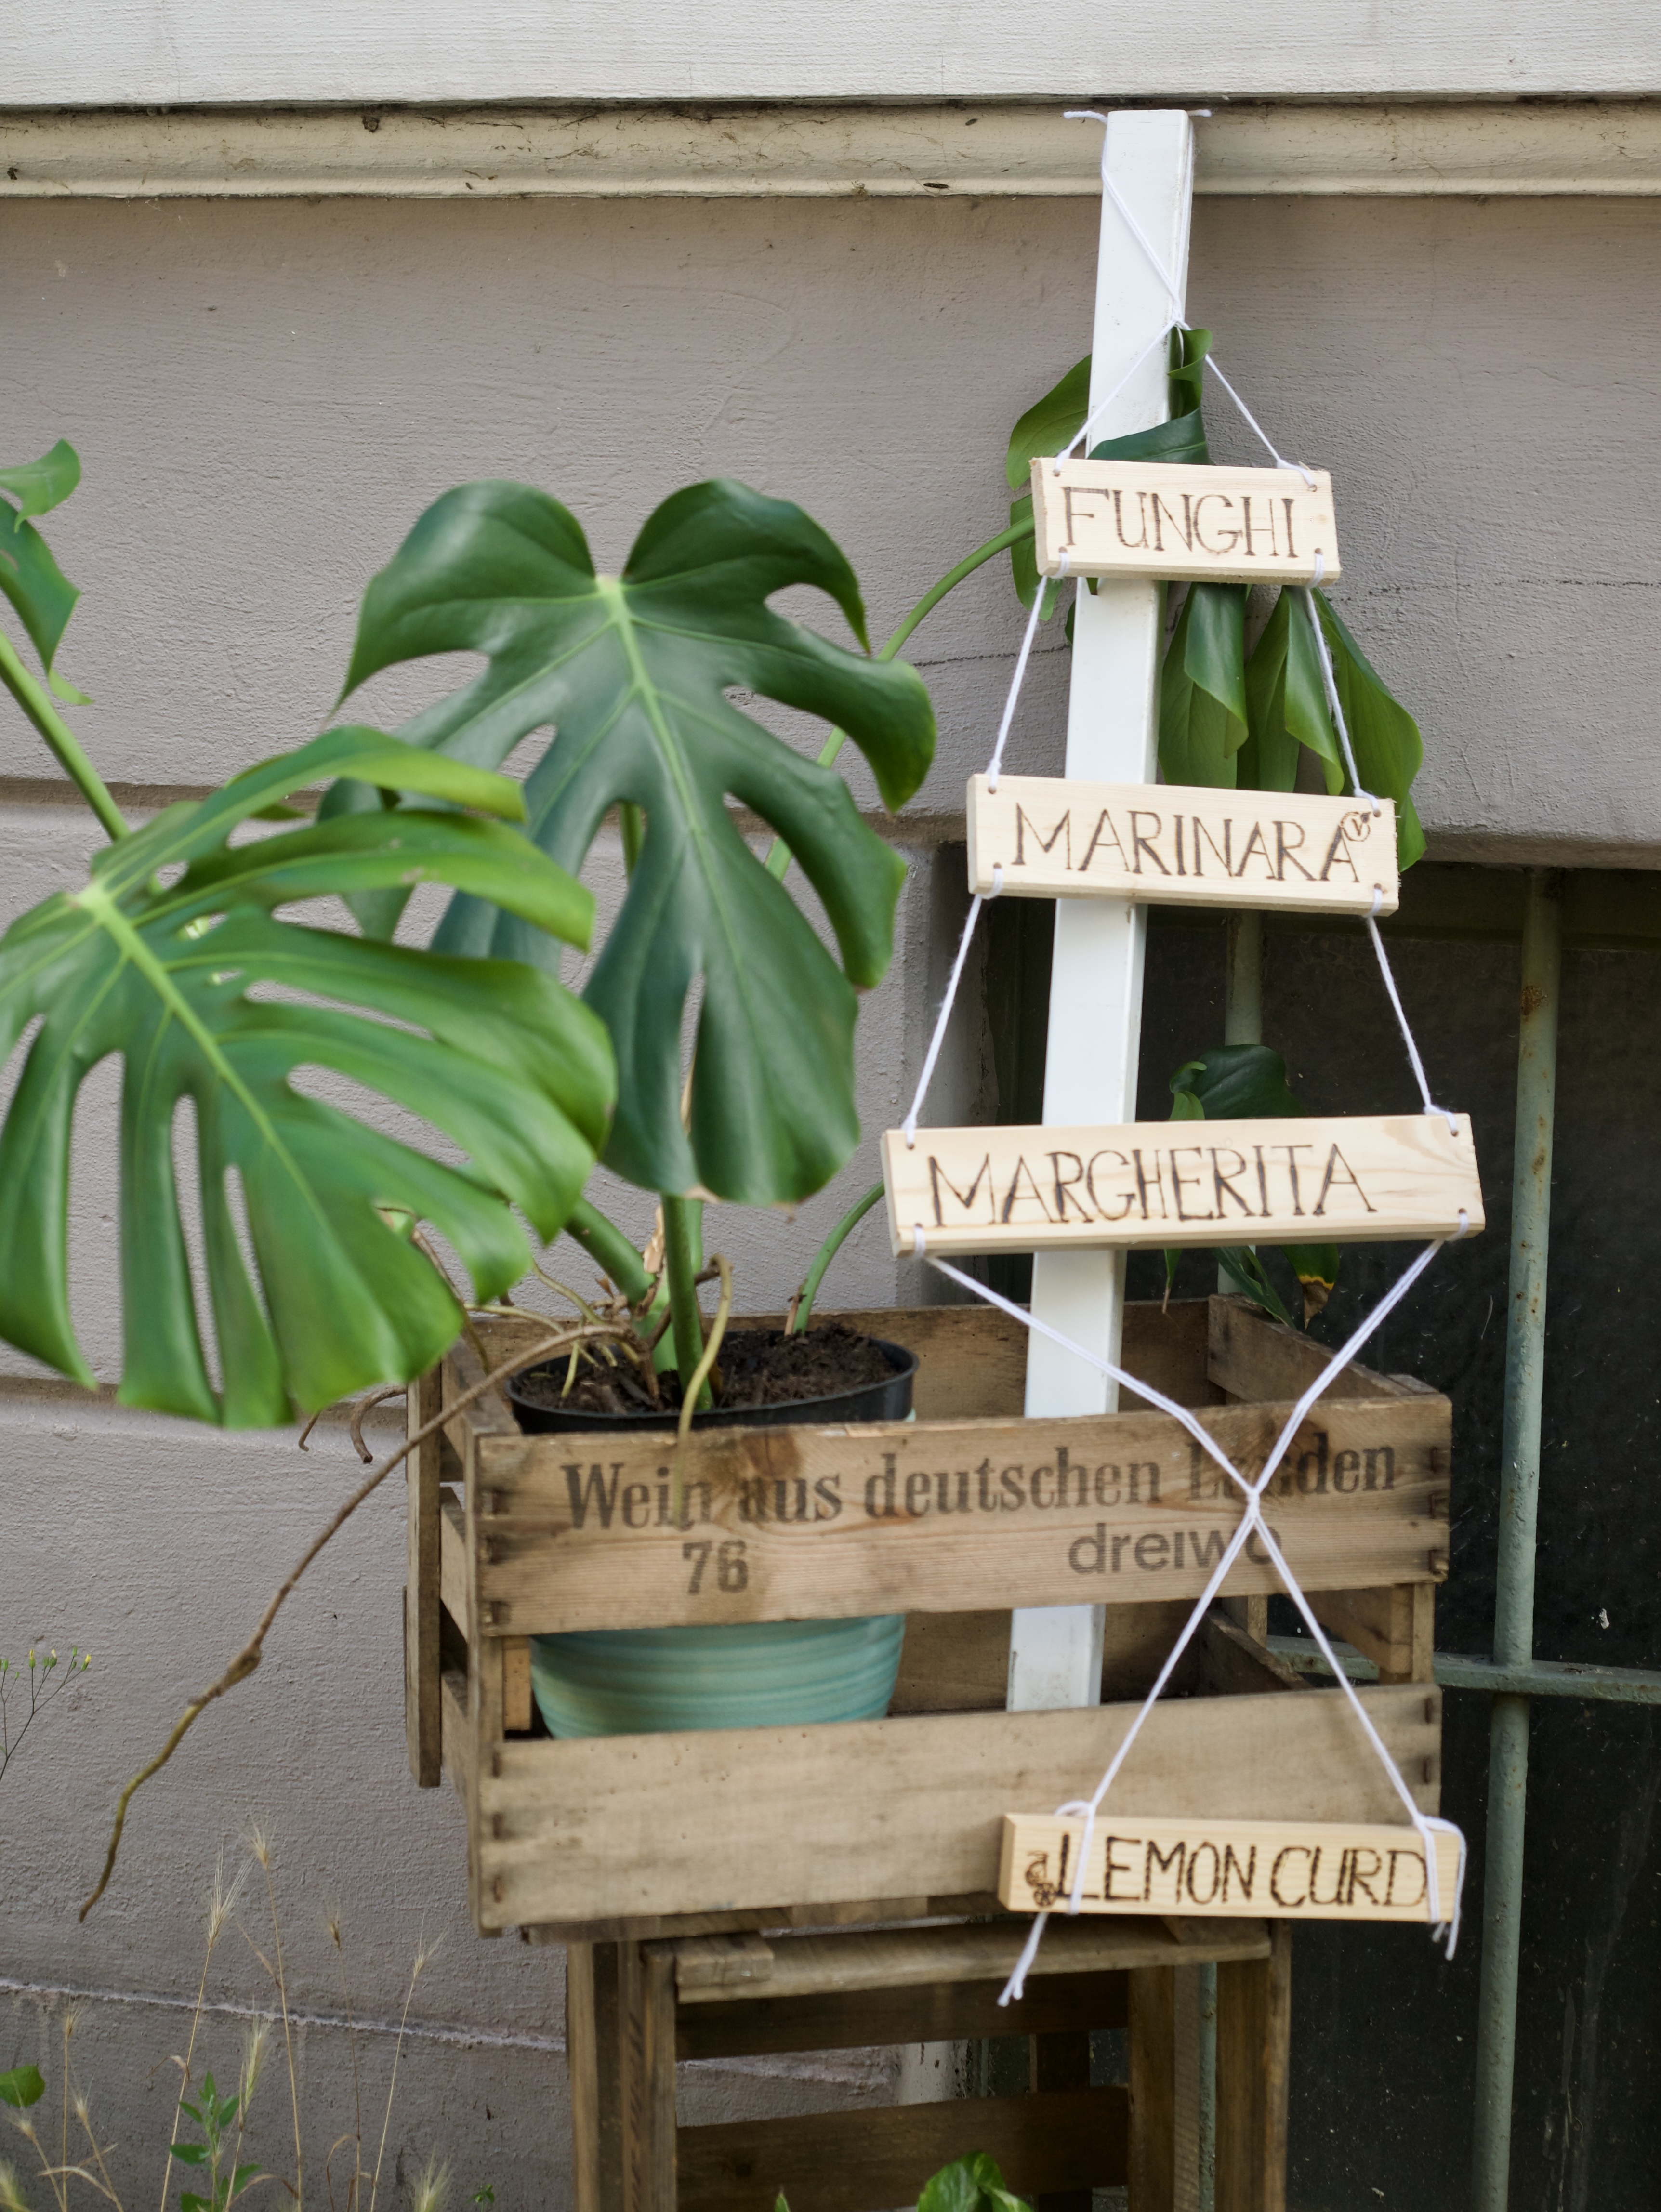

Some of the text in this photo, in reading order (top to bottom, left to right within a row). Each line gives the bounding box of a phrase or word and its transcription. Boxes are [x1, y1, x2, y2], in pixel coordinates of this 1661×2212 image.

[1060, 486, 1298, 558] FUNGHI
[1011, 802, 1359, 883] MARINARA
[928, 1143, 1379, 1227] MARGHERITA
[561, 1462, 713, 1531] Wein
[738, 1471, 842, 1524] aus
[864, 1447, 1161, 1518] deutschen
[682, 1540, 749, 1595] 76
[1055, 1834, 1429, 1908] LEMON CURD
